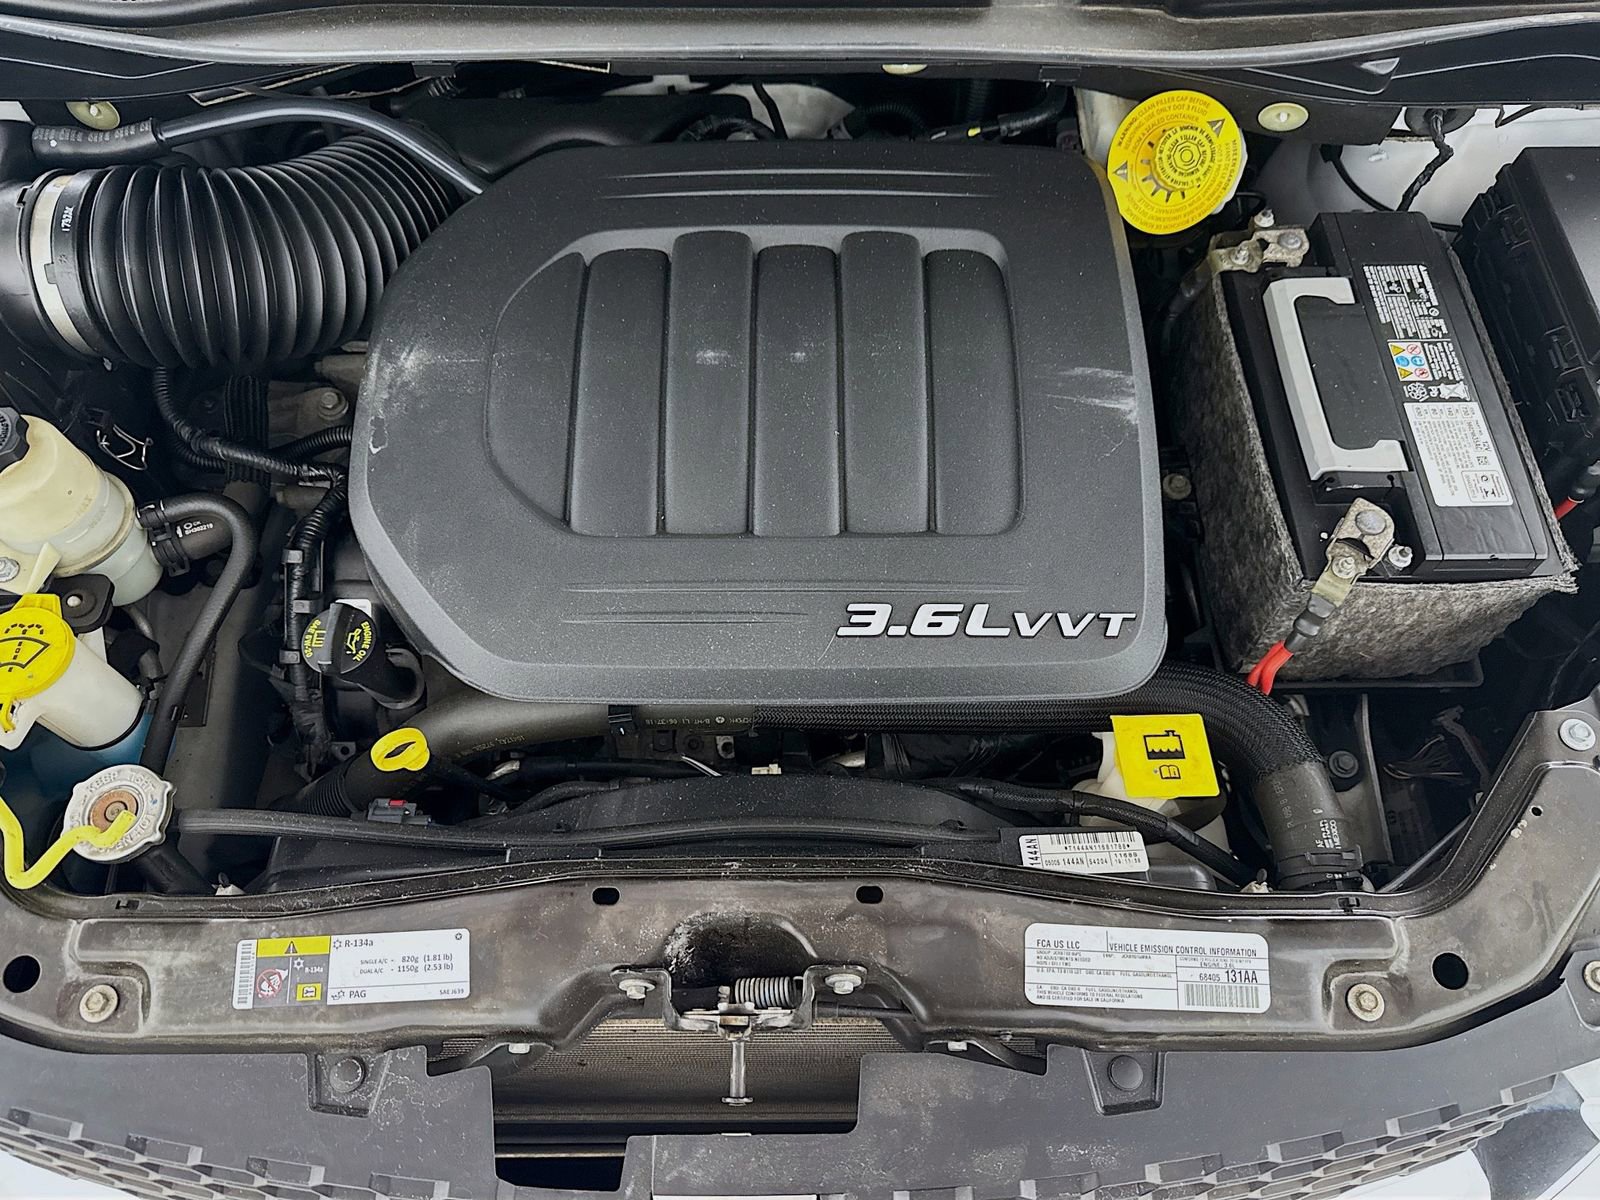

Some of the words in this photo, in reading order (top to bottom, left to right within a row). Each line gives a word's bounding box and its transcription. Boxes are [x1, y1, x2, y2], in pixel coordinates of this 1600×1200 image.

[1156, 96, 1175, 107] FILLER
[1176, 95, 1188, 103] CAP
[1189, 96, 1210, 108] BEFORE
[1013, 612, 1137, 638] VVT
[361, 621, 372, 650] ENGINE
[352, 650, 366, 662] OIL
[1025, 838, 1040, 866] 144AN
[1062, 858, 1084, 866] 144AN
[344, 938, 374, 948] R-134a
[1036, 939, 1050, 948] FCA
[1054, 940, 1064, 948] US
[1066, 940, 1080, 949] LLC
[1109, 943, 1138, 952] VEHICLE
[1140, 944, 1174, 954] EMISSION
[1176, 946, 1207, 955] CONTROL
[1210, 948, 1256, 957] INFORMATION
[402, 956, 418, 964] 820g
[423, 954, 440, 962] (1.81
[443, 953, 453, 962] lb)
[398, 965, 419, 973] 1150g
[424, 964, 442, 972] (2.53
[444, 962, 454, 970] lb)
[1200, 972, 1220, 981] 68405
[1225, 969, 1258, 983] 131AA
[350, 990, 366, 998] PAG
